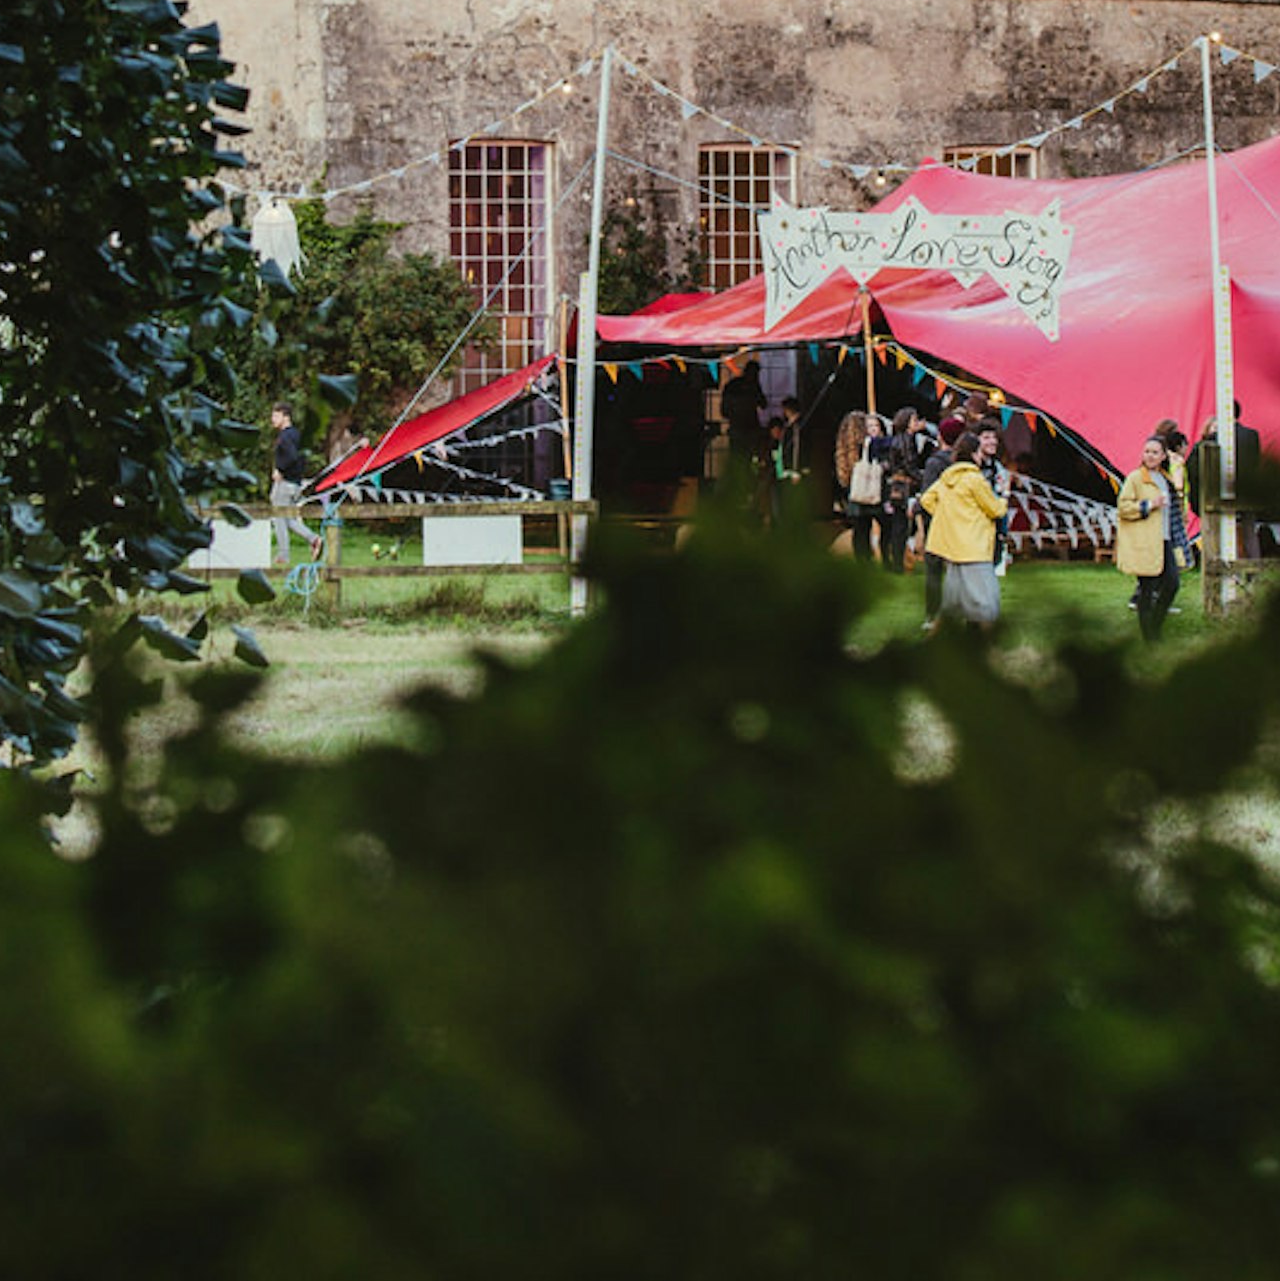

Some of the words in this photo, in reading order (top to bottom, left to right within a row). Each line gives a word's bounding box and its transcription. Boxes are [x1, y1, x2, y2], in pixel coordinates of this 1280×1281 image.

[767, 212, 877, 307] Another
[882, 208, 980, 267] Love
[988, 220, 1062, 317] Story
